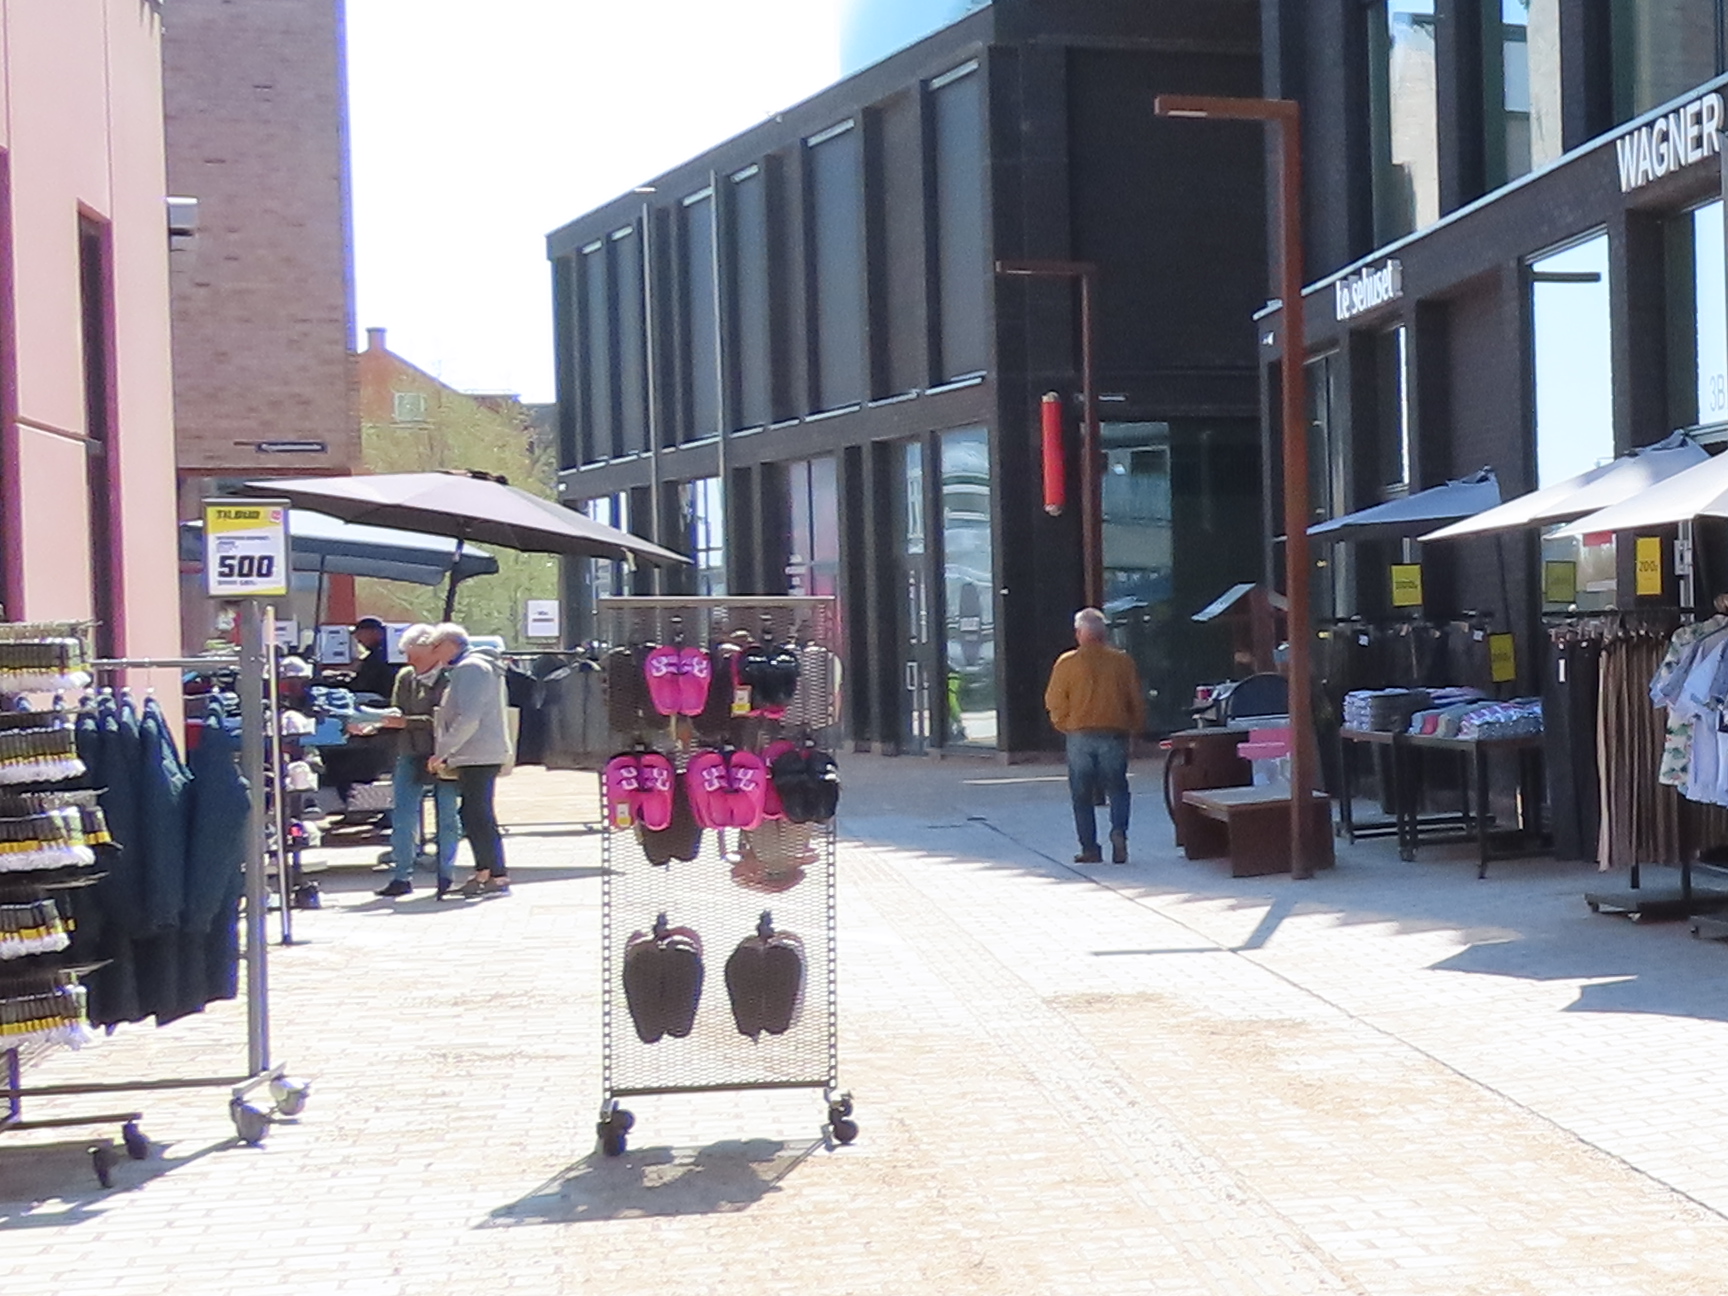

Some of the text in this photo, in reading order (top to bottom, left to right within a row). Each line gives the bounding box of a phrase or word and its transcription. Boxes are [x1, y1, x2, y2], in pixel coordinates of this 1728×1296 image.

[1616, 92, 1724, 192] WAGNER
[1709, 375, 1726, 411] 3B
[218, 555, 275, 578] 500
